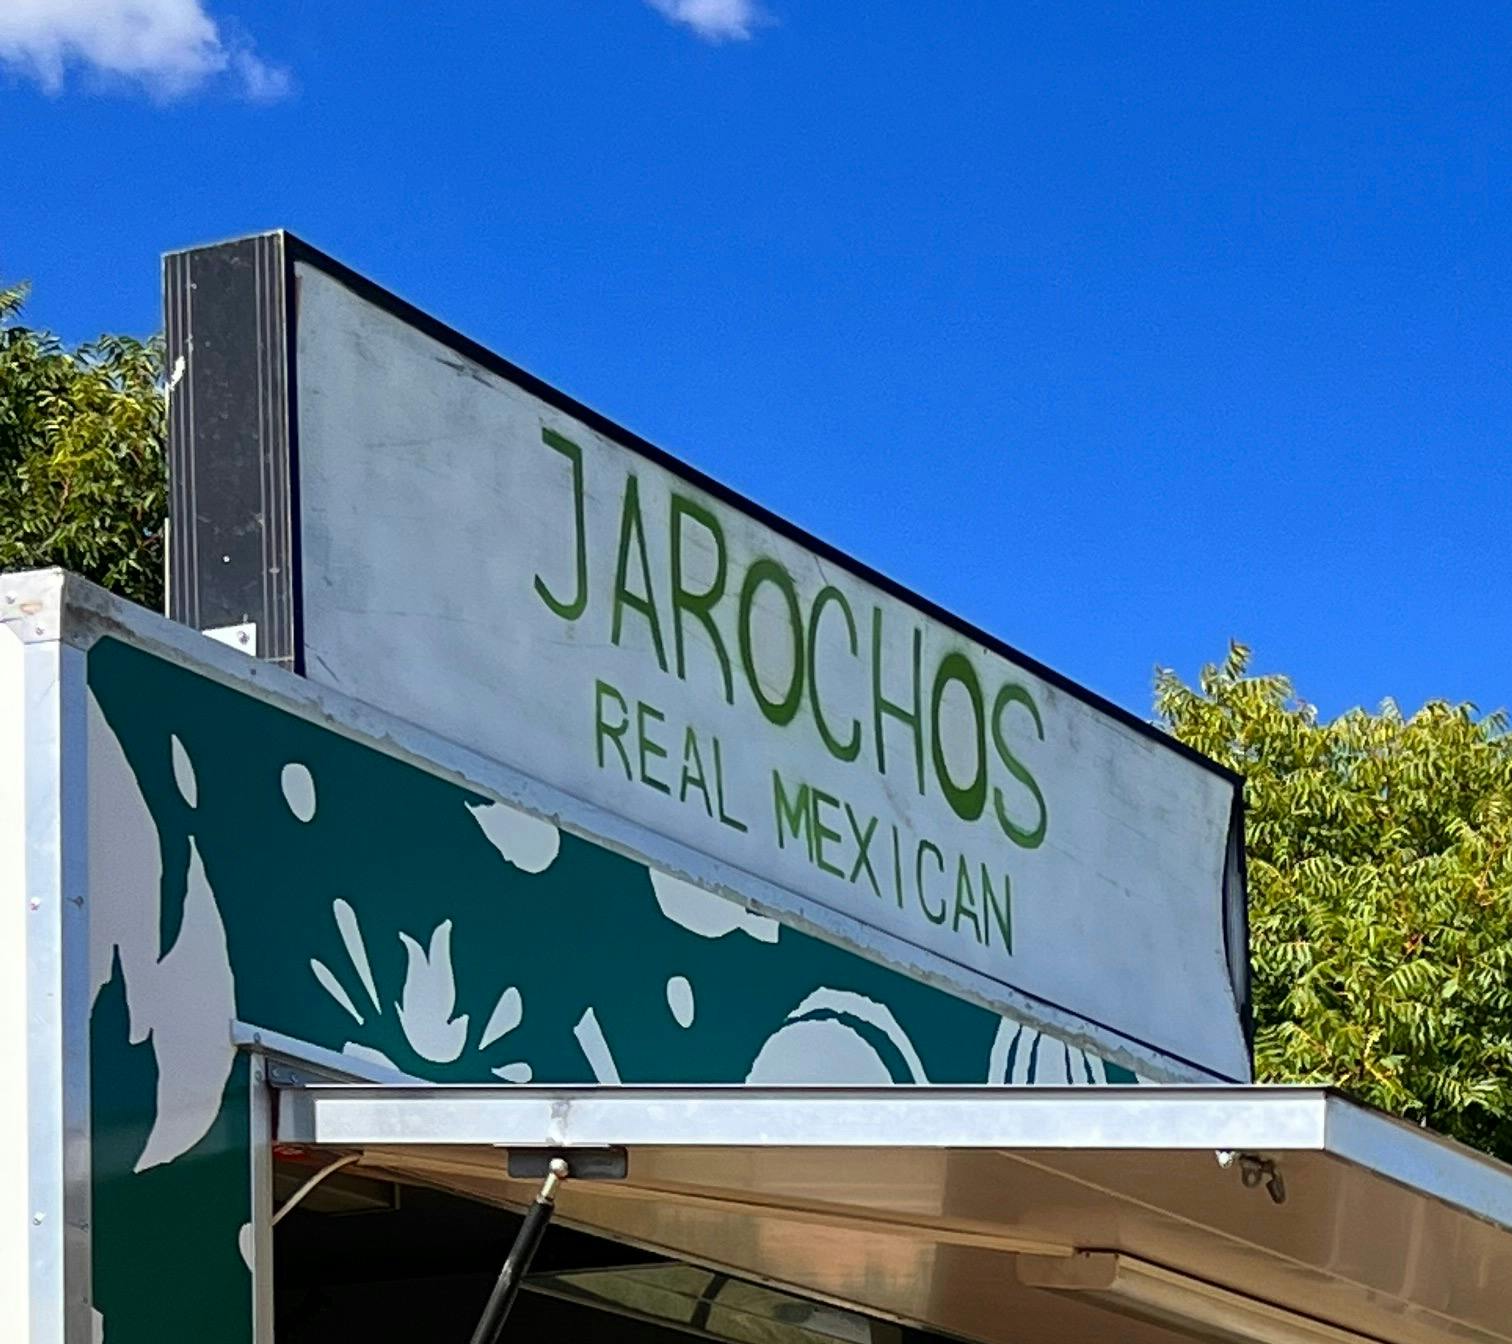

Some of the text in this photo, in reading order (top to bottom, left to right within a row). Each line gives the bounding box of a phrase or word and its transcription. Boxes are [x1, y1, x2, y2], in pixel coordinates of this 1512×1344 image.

[533, 428, 1048, 850] JAROCHOS
[595, 679, 1014, 957] REAL MEXICAN
